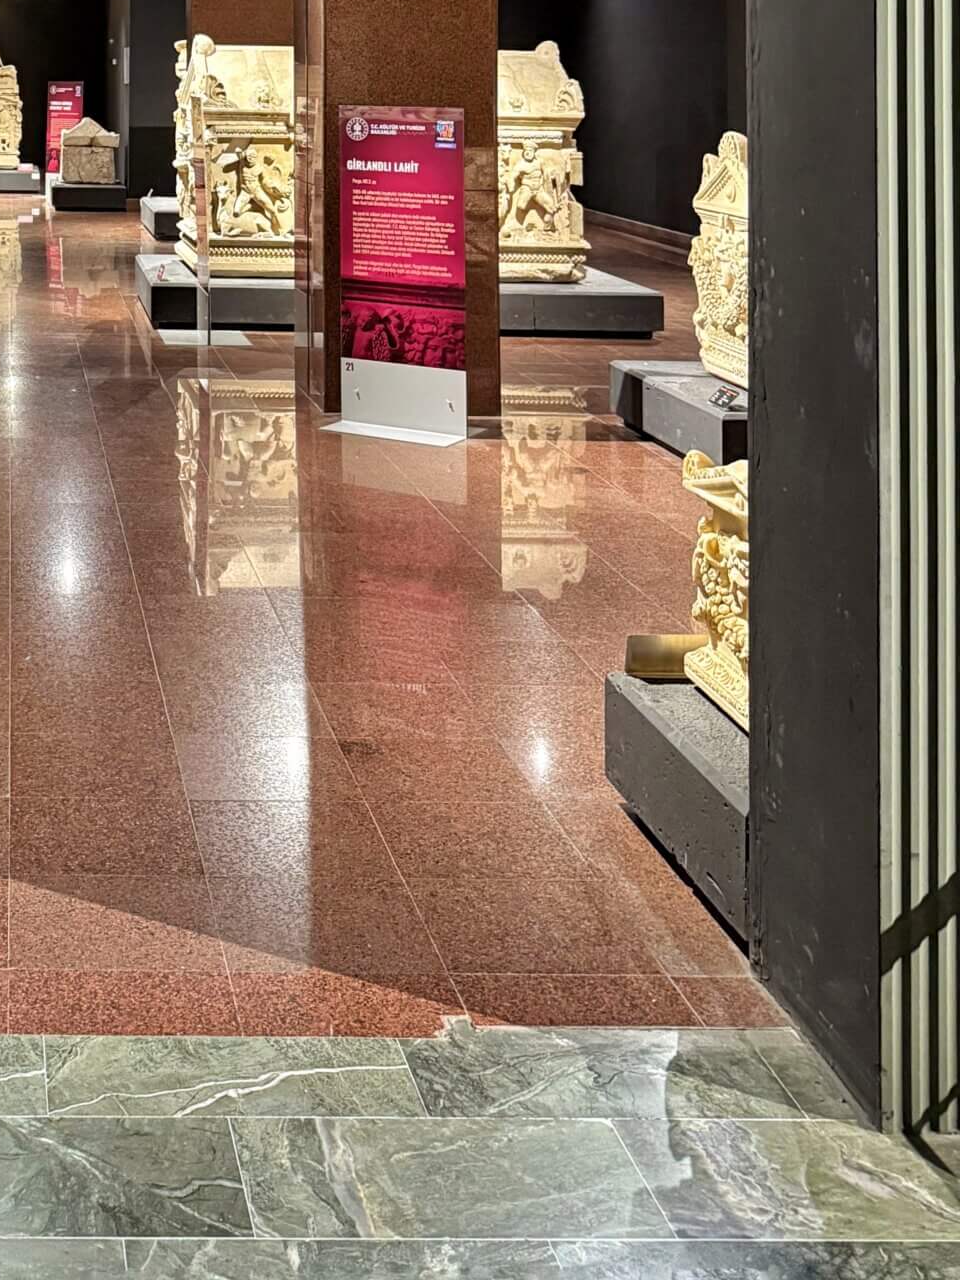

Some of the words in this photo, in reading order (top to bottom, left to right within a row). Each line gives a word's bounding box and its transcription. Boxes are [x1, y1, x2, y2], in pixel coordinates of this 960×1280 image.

[346, 158, 391, 172] GİRLANDLI
[394, 160, 419, 173] LAHİT
[345, 362, 354, 371] 21
